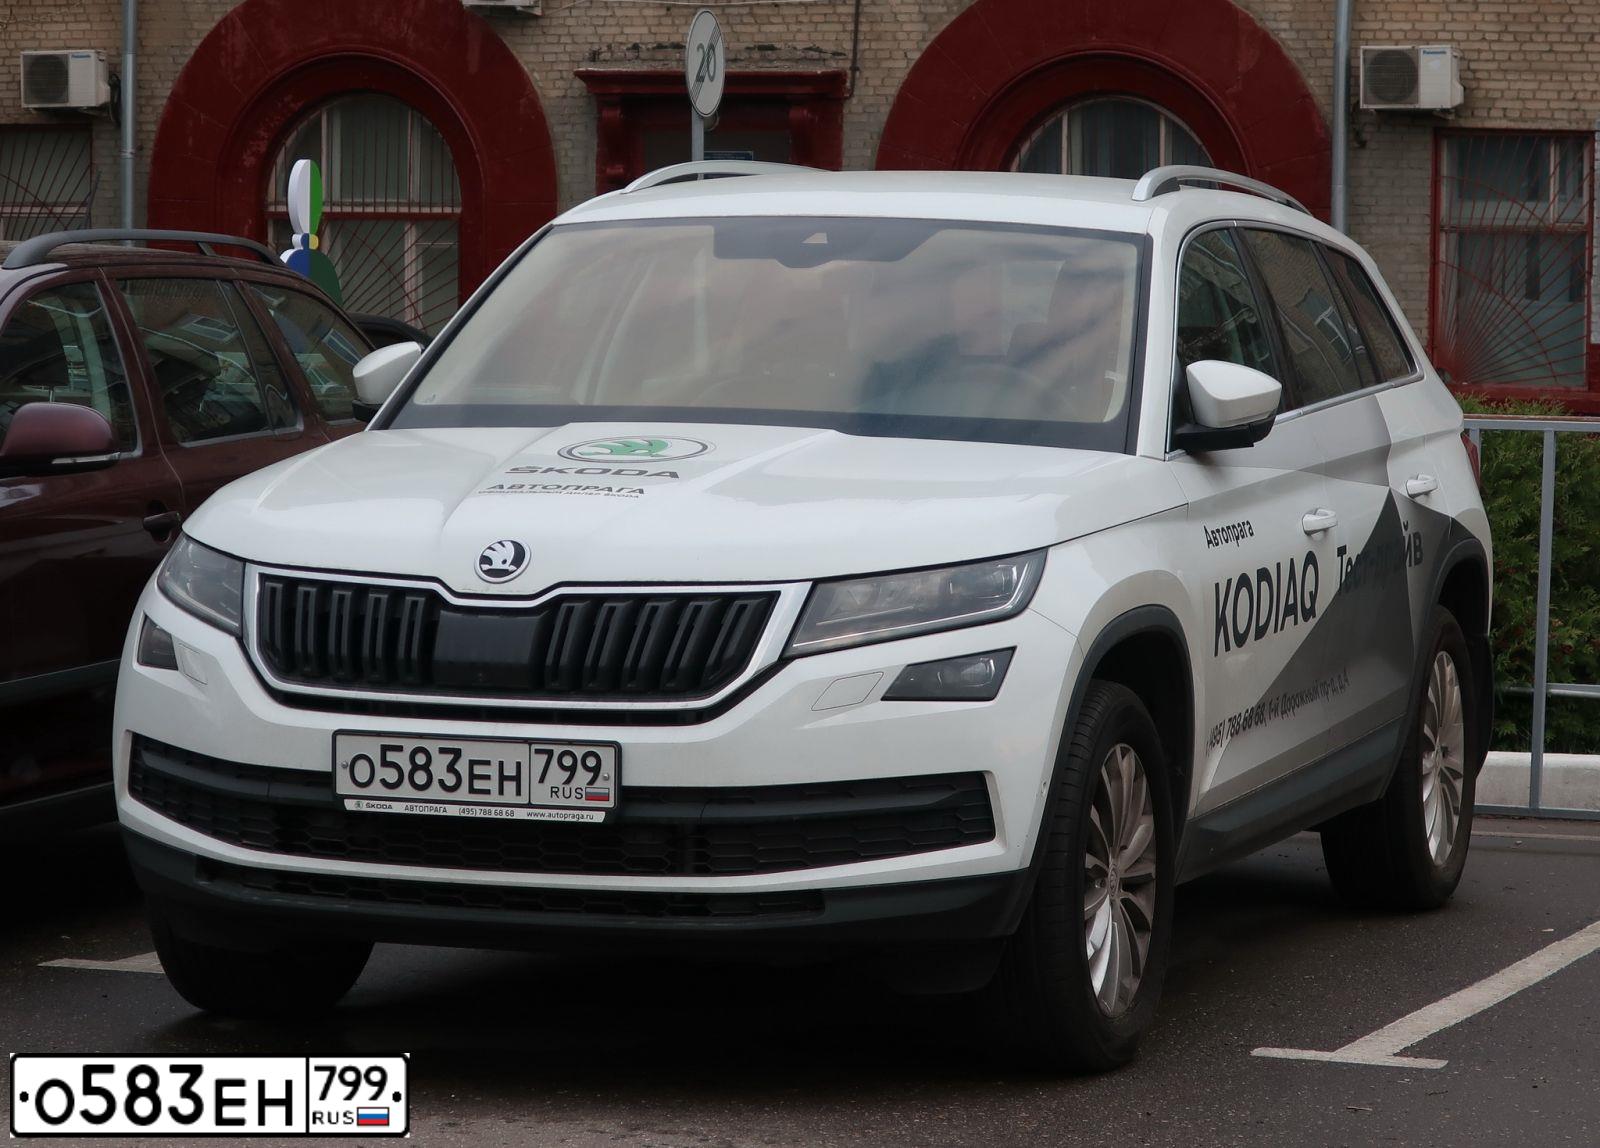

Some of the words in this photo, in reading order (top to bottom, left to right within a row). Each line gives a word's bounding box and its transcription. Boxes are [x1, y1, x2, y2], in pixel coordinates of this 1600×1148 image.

[696, 42, 717, 82] 20
[486, 483, 645, 495] АВТОПРАГА
[1203, 519, 1255, 550] Автопрага
[1213, 549, 1320, 658] KODIAQ
[349, 743, 522, 797] O583EH
[533, 748, 603, 786] 799
[549, 786, 584, 800] RUS
[404, 804, 448, 814] АВТОПРАГА
[458, 806, 478, 817] (495)
[478, 808, 493, 817] 788
[493, 809, 504, 817] 68
[504, 809, 515, 818] 68
[526, 810, 594, 822] www.autopraga.ru
